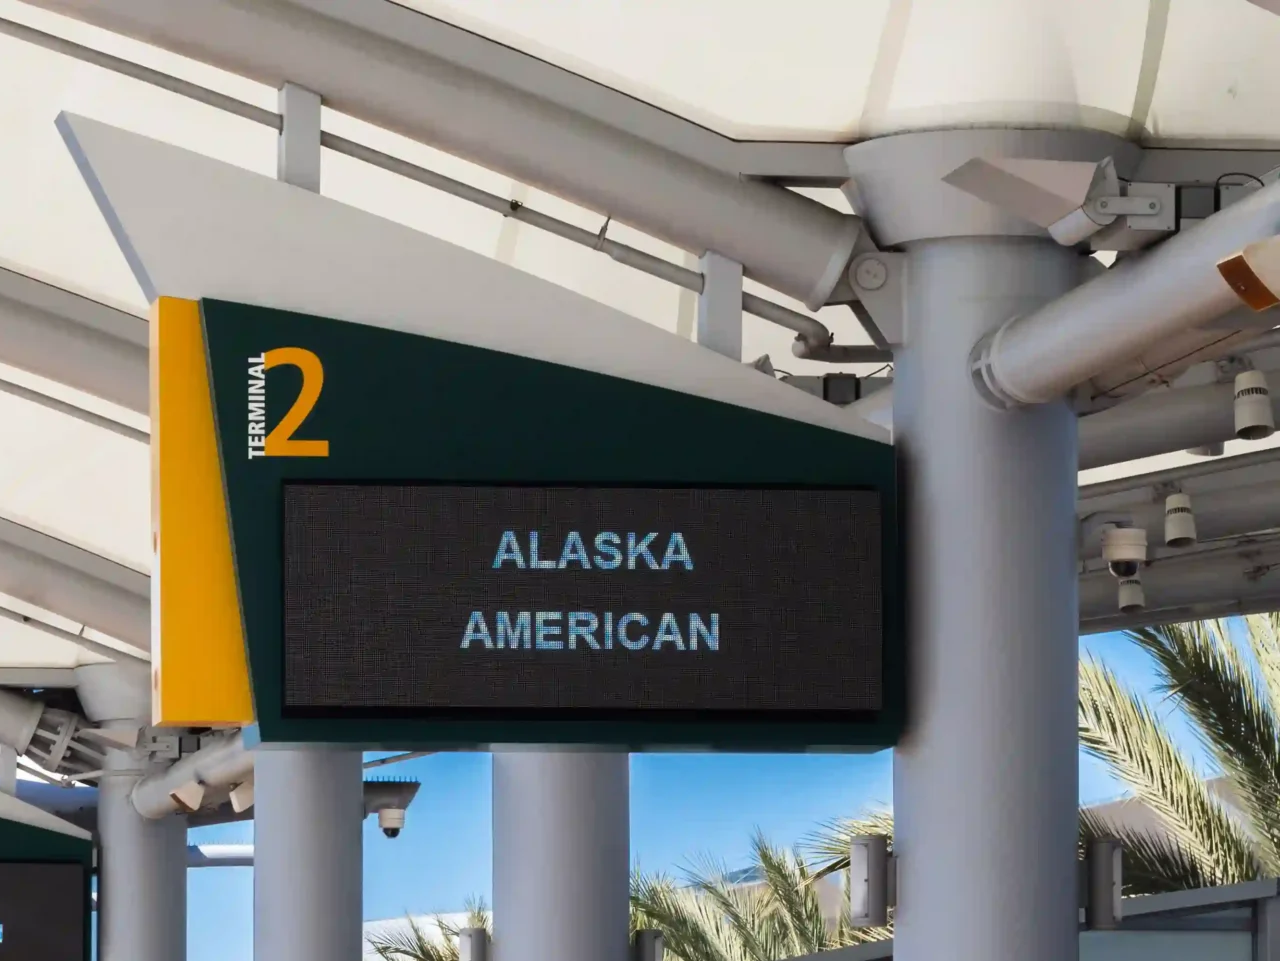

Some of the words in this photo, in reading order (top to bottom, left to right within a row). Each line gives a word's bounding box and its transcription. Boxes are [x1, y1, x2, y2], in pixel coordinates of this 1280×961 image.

[248, 352, 265, 459] TERMINAL
[264, 347, 329, 456] 2
[492, 531, 693, 570] ALASKA
[460, 611, 719, 650] AMERICAN
